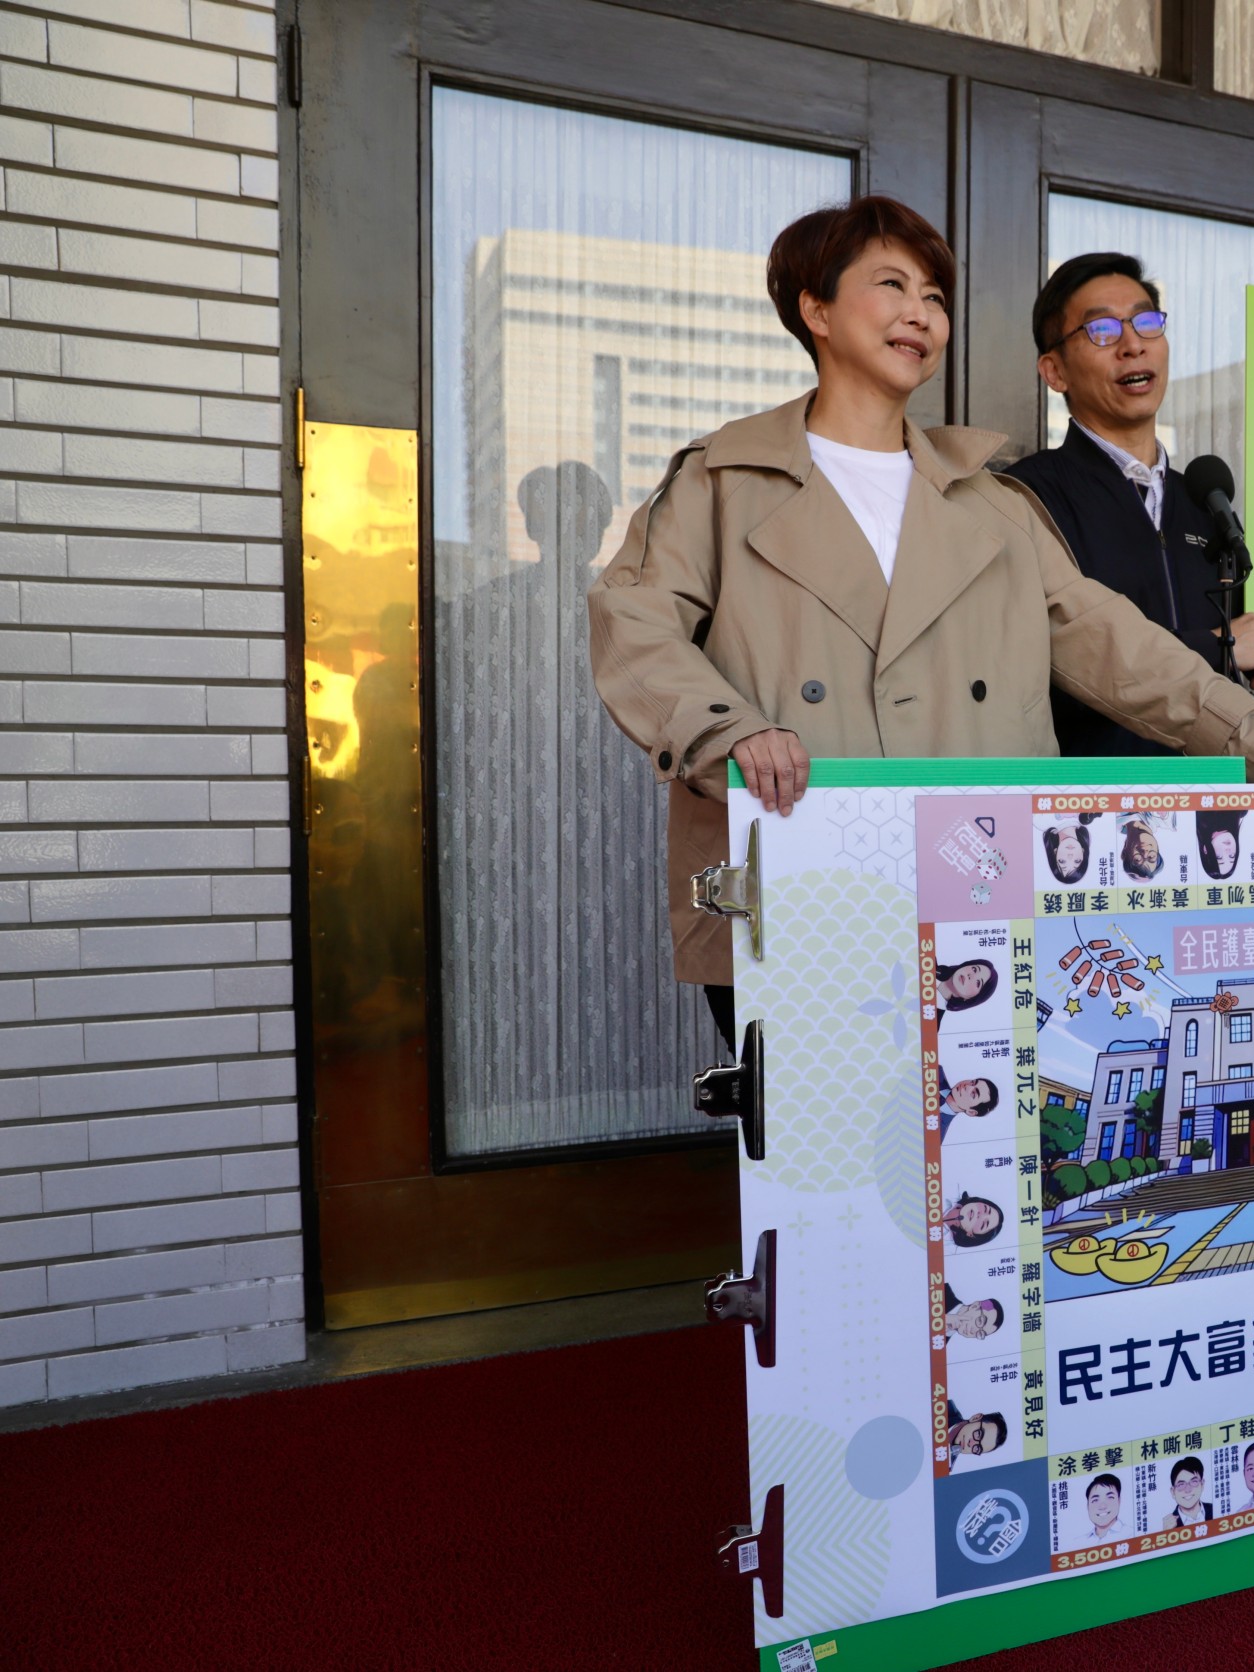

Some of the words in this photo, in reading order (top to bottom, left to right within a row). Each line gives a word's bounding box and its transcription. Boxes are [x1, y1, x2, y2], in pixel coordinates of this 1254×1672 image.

[1127, 887, 1190, 910] 黃漸冰
[1013, 937, 1034, 1010] 王紅危
[1015, 1045, 1038, 1120] 葉兀之
[1018, 1154, 1040, 1226] 陳一針
[1024, 1369, 1044, 1440] 黃見好
[1057, 1447, 1125, 1478] 涂拳擊
[1141, 1431, 1203, 1461] 林嘶鳴
